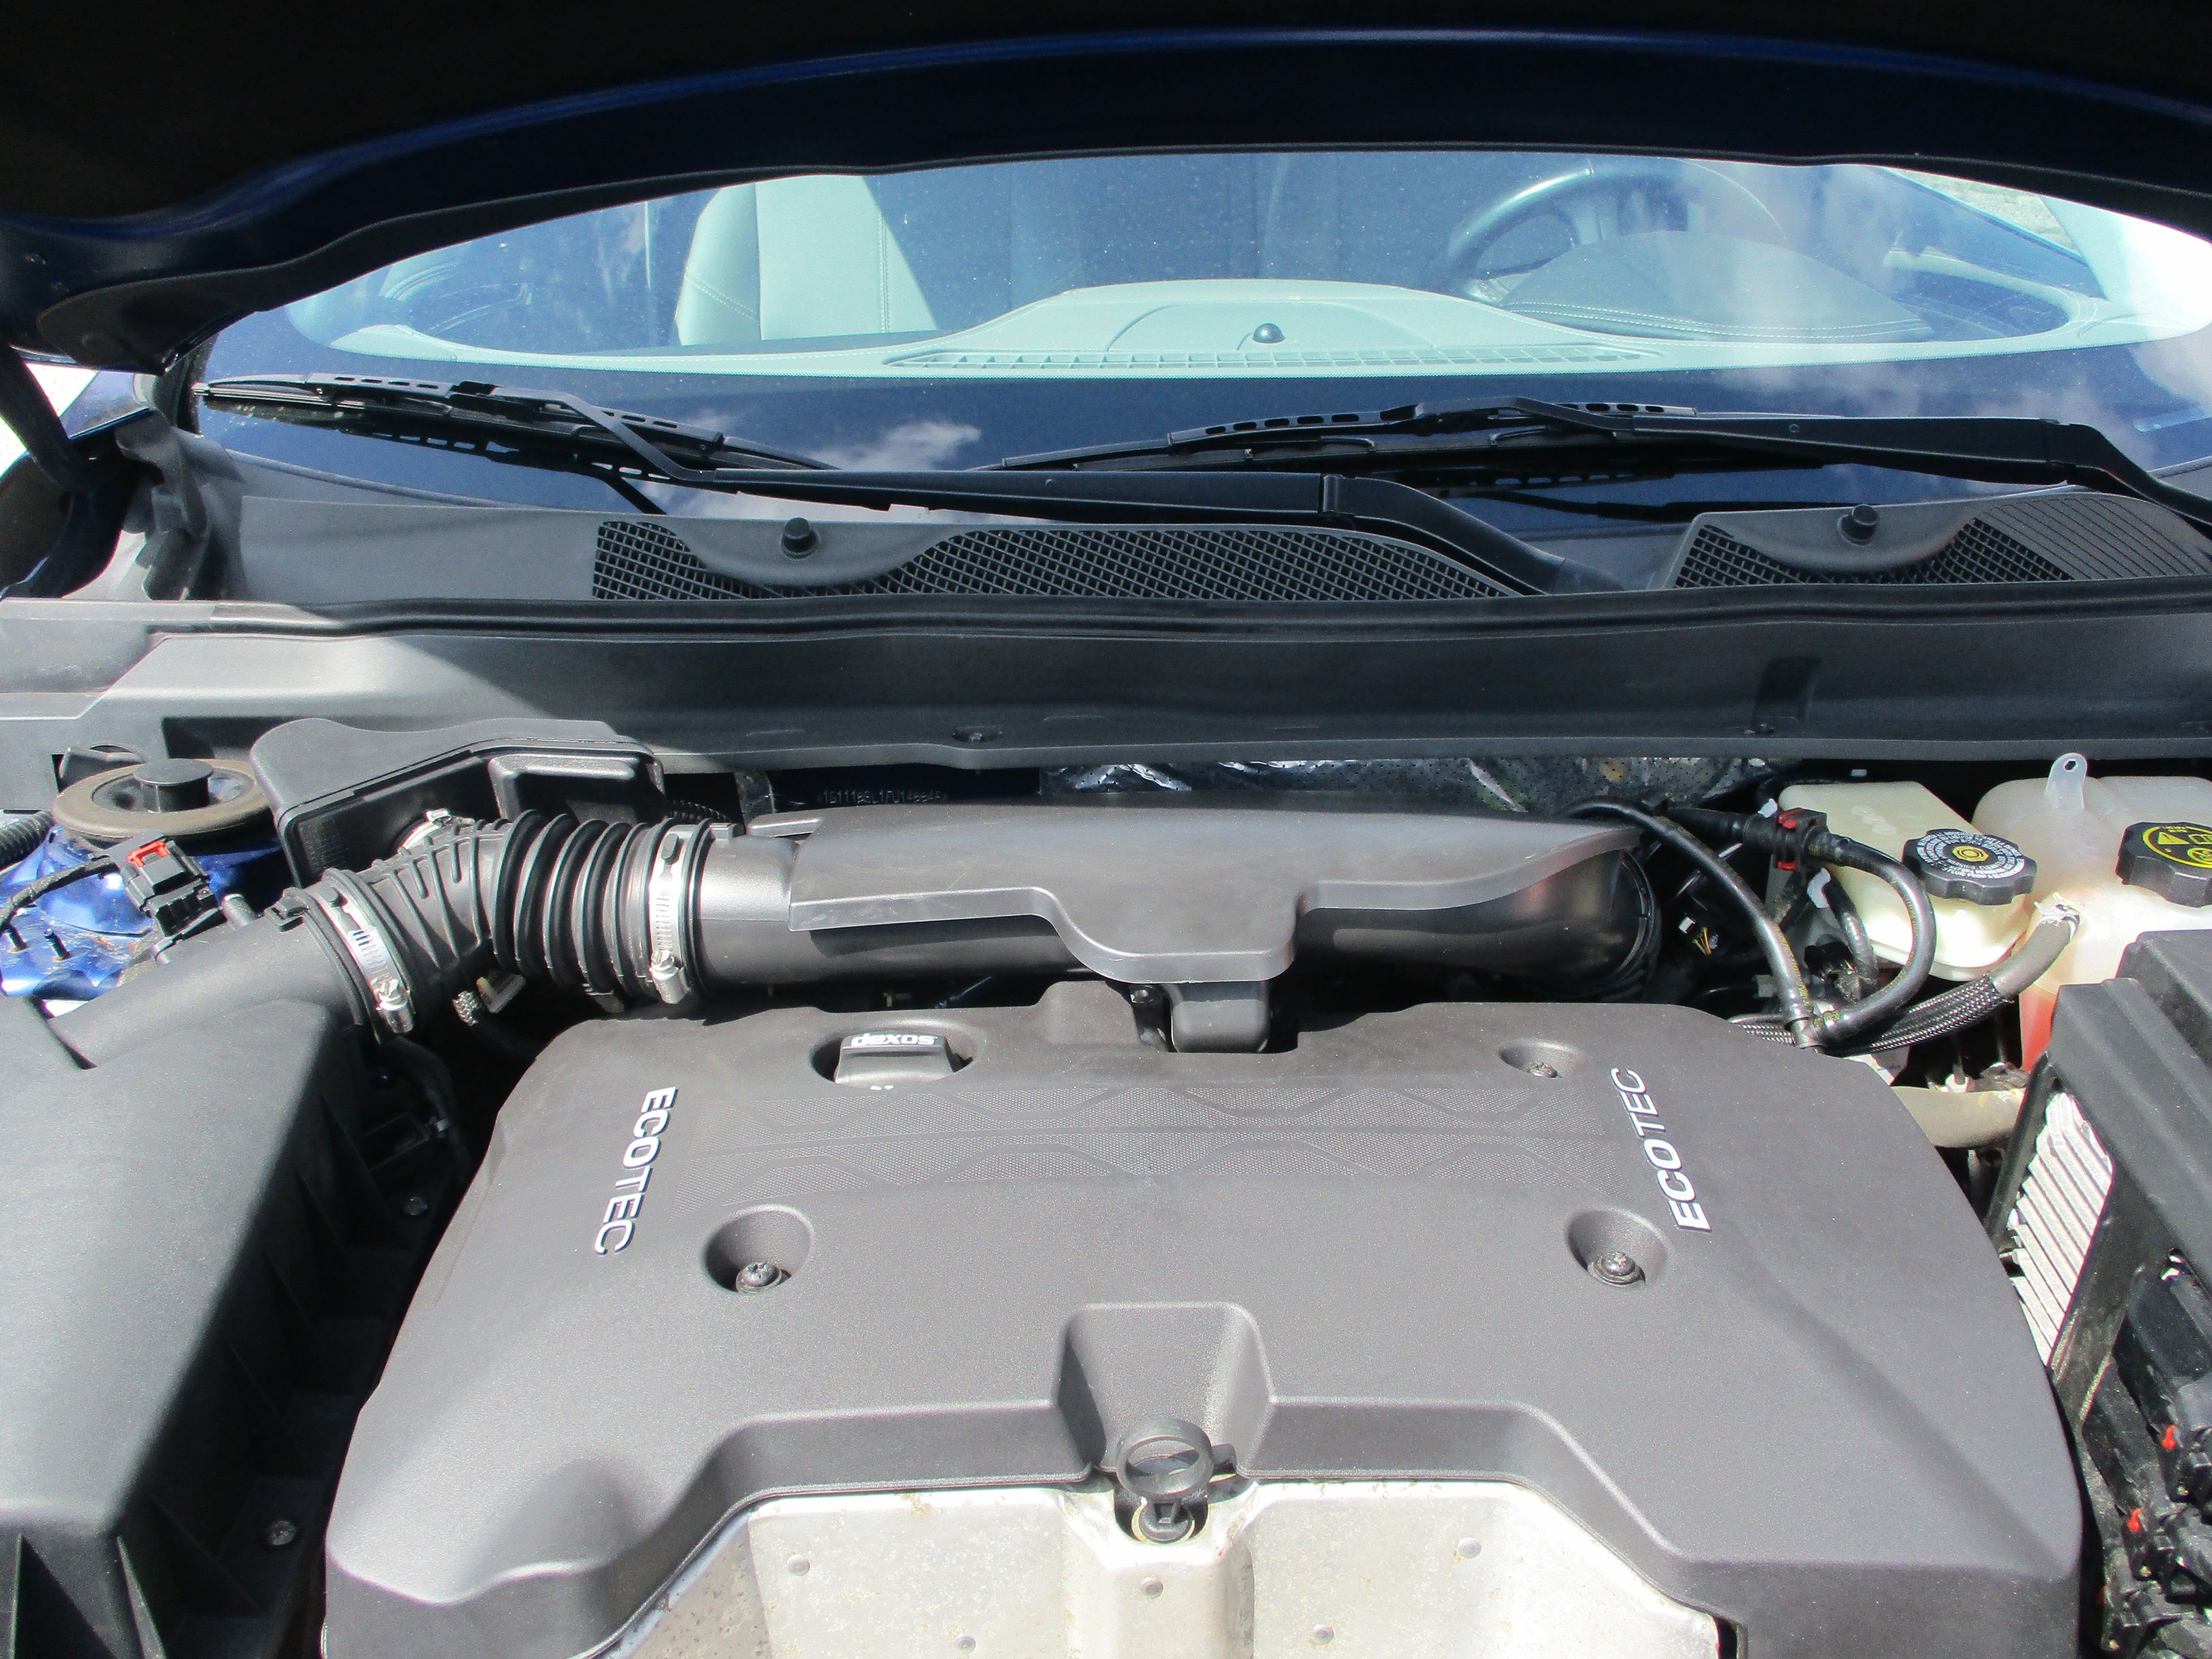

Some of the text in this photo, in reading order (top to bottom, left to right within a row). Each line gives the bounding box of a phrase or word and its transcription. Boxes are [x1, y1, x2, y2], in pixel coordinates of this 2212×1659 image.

[851, 1033, 935, 1047] dexos
[595, 1086, 677, 1255] ECOTEC
[1610, 1067, 1712, 1231] ECOTEC
